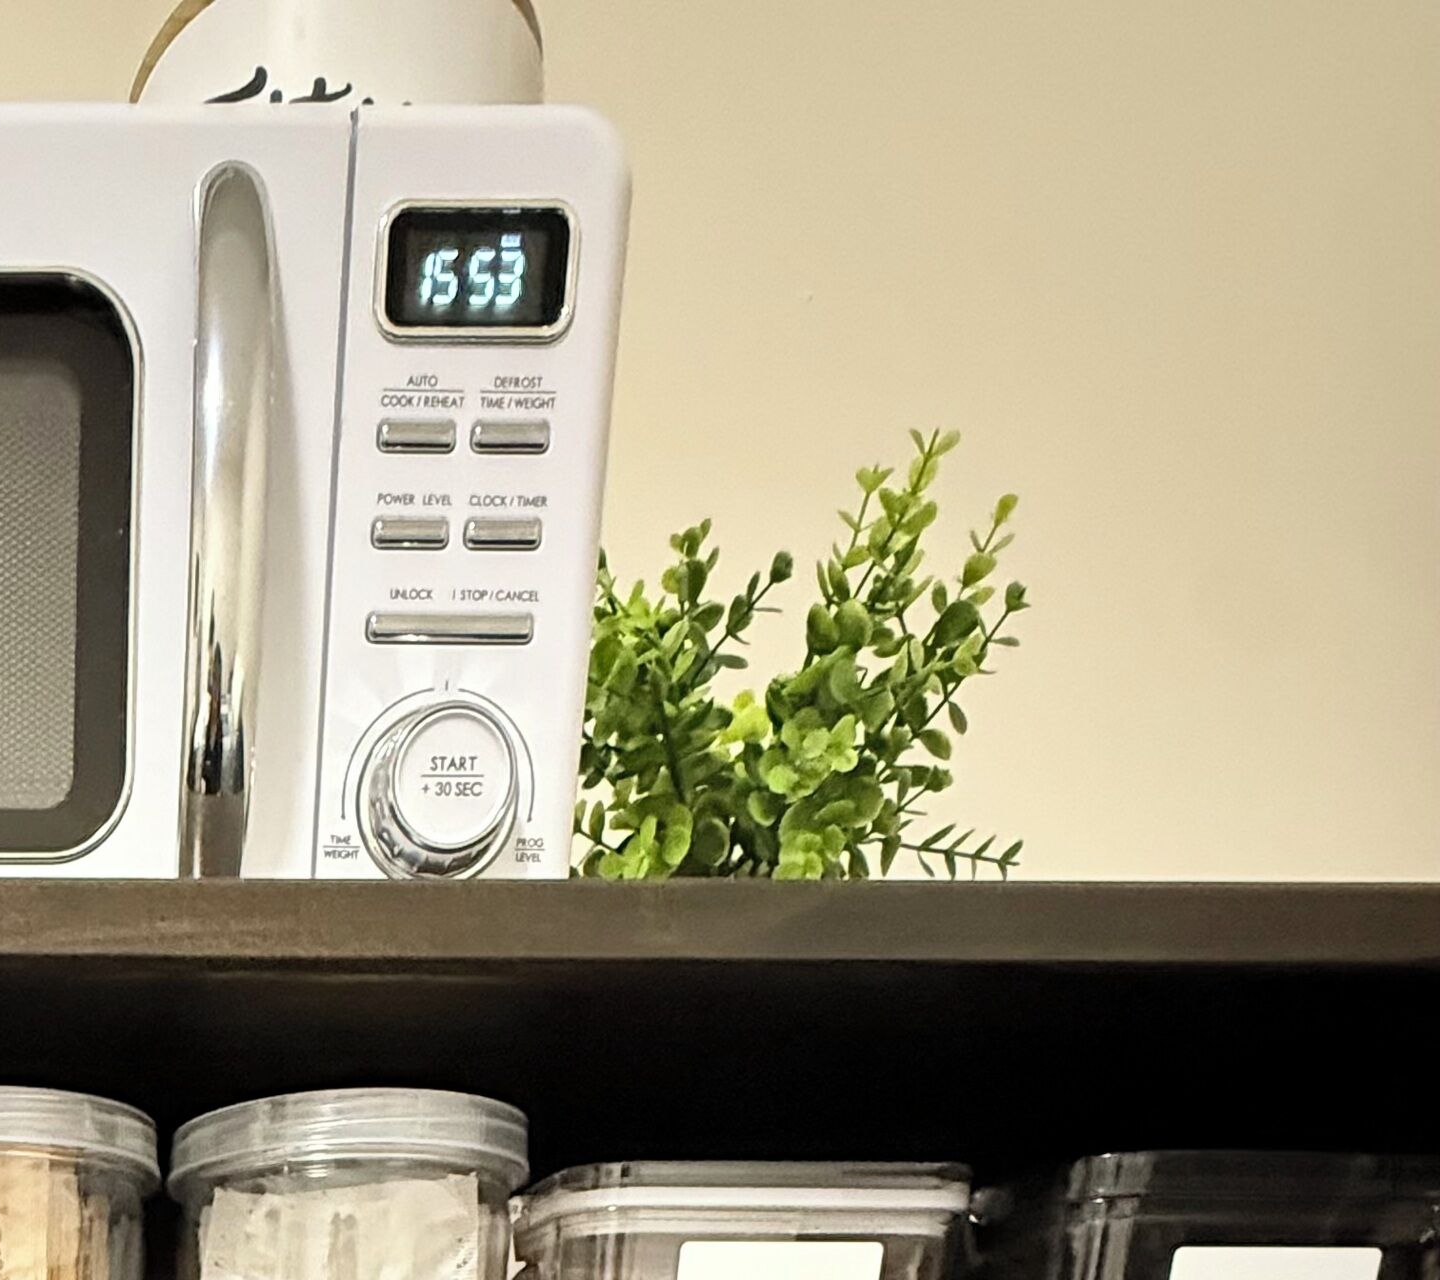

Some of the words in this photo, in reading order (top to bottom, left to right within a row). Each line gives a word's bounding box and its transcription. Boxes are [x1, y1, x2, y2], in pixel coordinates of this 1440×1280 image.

[407, 375, 438, 387] AUTO
[494, 376, 543, 388] DEFROST
[381, 395, 416, 407] COOK
[423, 396, 465, 408] REHEAT
[480, 397, 506, 409] TIME
[514, 397, 556, 410] WEIGHT
[377, 493, 415, 506] POWER
[422, 494, 452, 506] LEVEL
[469, 494, 507, 507] CLOCK
[517, 495, 548, 508] TIMER
[390, 588, 433, 600] UNLOCK
[460, 589, 488, 601] STOP
[495, 590, 539, 602] CANCEL
[430, 756, 478, 772] START
[435, 781, 453, 797] 30
[455, 782, 484, 797] SEC
[330, 835, 352, 846] TIME
[515, 837, 544, 848] PROG
[324, 849, 359, 861] WEIGHT
[515, 852, 542, 864] LEVEL
